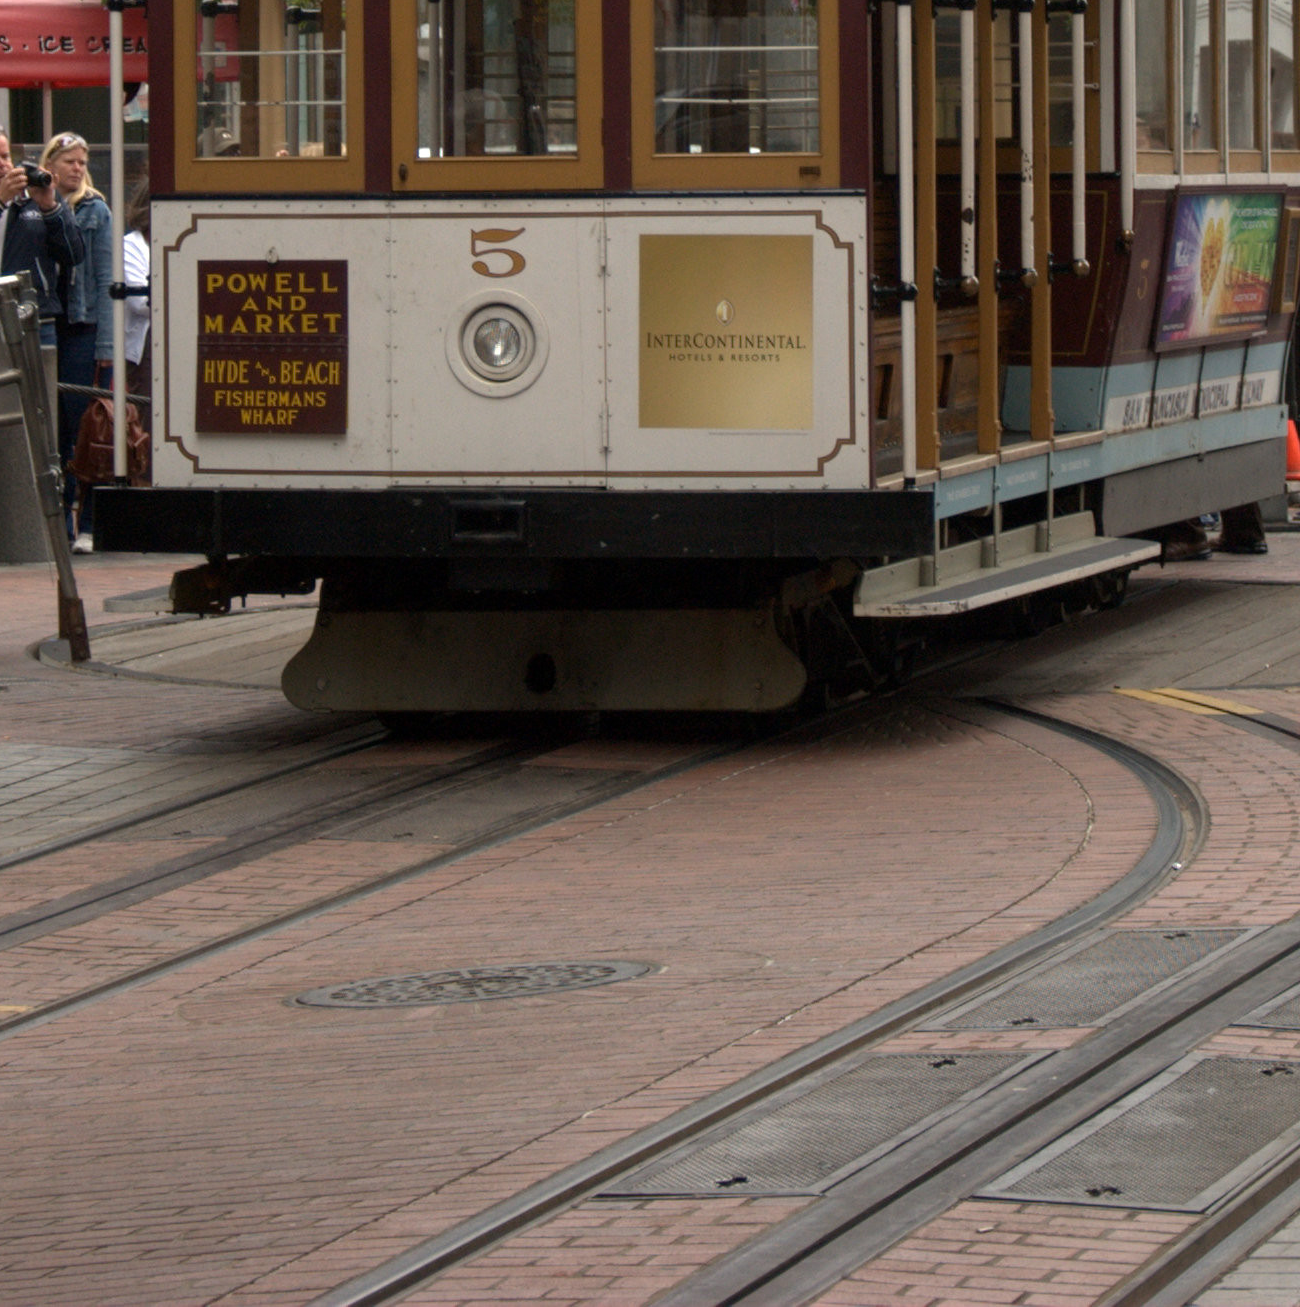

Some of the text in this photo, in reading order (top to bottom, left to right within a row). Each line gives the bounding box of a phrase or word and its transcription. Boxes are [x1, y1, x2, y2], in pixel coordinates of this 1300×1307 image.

[471, 227, 526, 278] 5
[207, 272, 338, 294] POWELL
[241, 296, 307, 311] AND
[204, 313, 342, 334] MARKET
[669, 354, 712, 362] HOTELS
[731, 354, 781, 363] RESORTS
[204, 360, 341, 385] HYDE AND BEACH
[214, 390, 327, 407] FISHERMANS
[241, 409, 299, 425] WHARF
[1123, 398, 1143, 426] SAN
